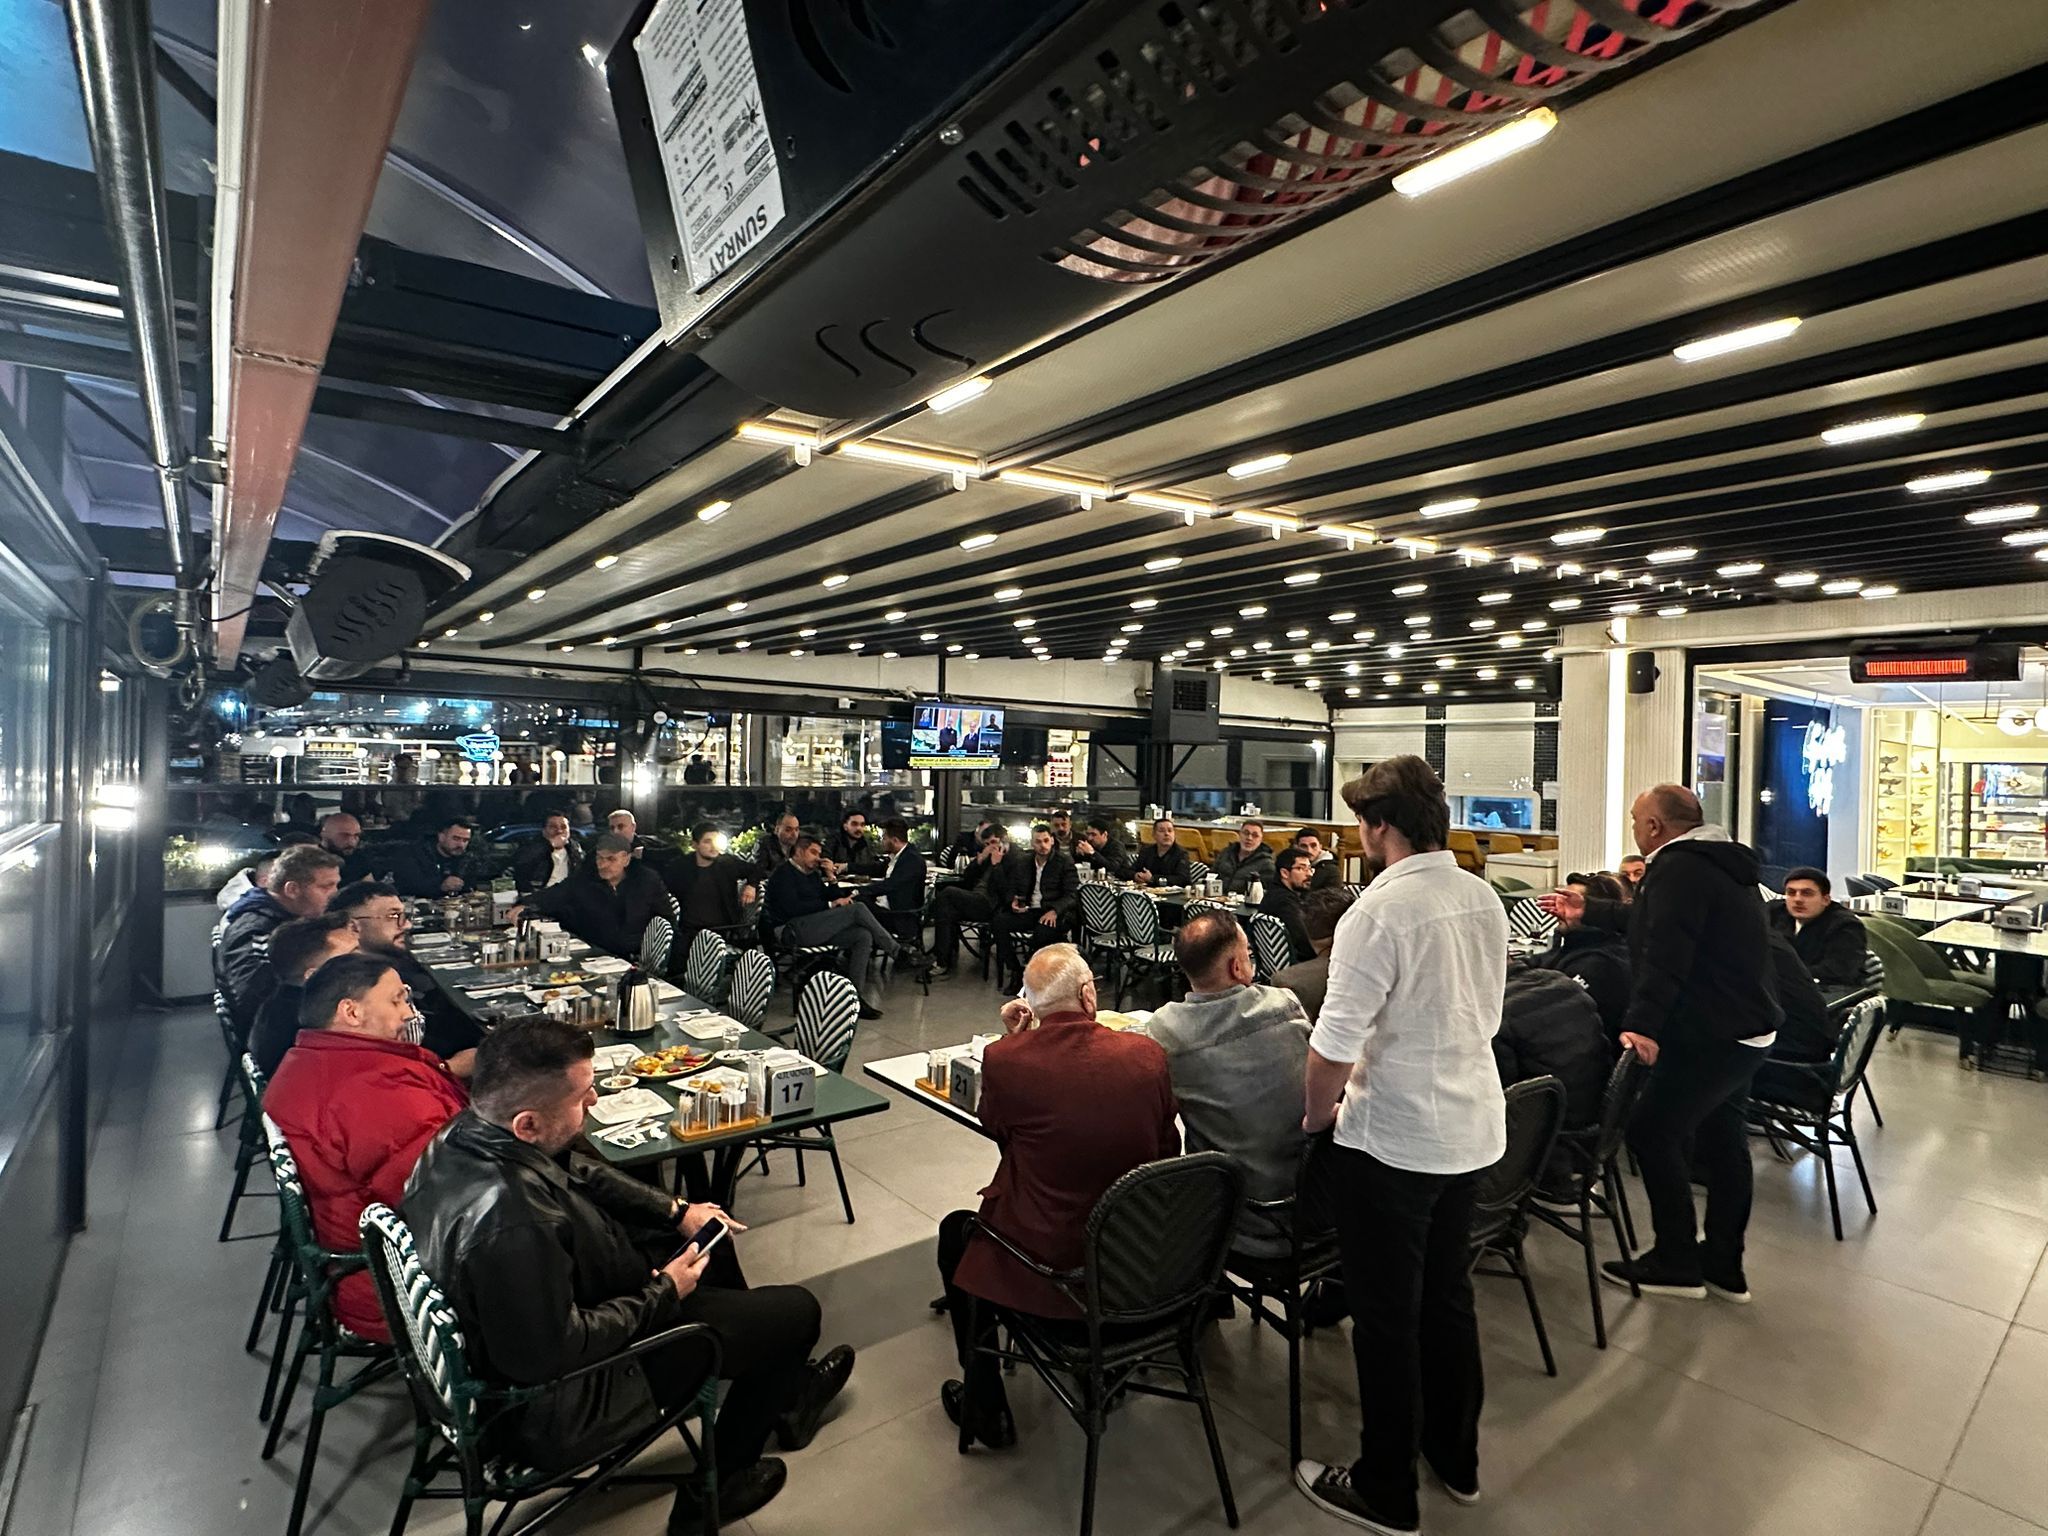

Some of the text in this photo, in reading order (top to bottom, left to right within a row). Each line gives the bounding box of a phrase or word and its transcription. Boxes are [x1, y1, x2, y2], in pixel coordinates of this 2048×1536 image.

[709, 204, 768, 278] SUNRAY
[2006, 916, 2022, 926] 05
[781, 1081, 804, 1104] 17
[955, 1073, 968, 1097] 21
